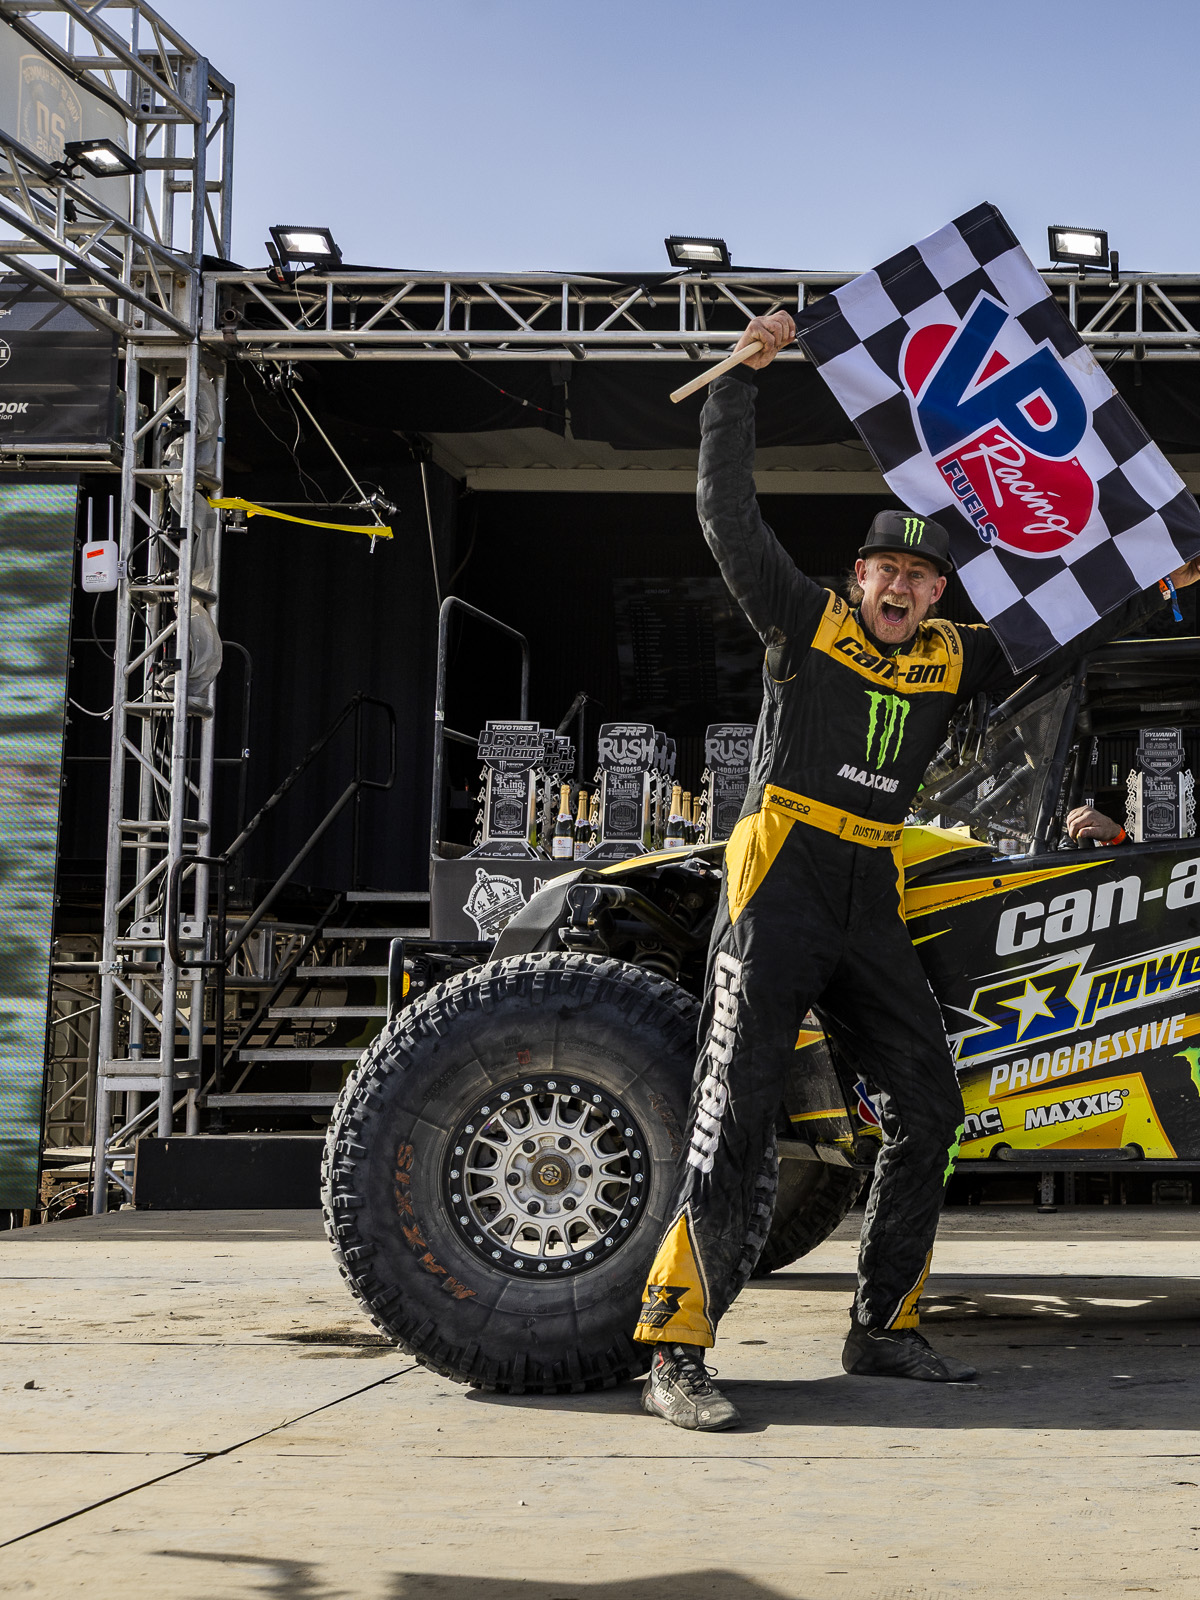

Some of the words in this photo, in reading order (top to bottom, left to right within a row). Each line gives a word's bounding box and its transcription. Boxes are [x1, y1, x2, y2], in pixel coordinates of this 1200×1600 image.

[915, 293, 1090, 461] VP
[941, 458, 999, 544] FUELS
[961, 433, 1078, 539] Racing
[833, 636, 947, 684] can-am
[477, 746, 545, 760] Challenge
[478, 730, 545, 747] Desert
[598, 737, 656, 764] RUSH
[609, 765, 642, 773] 1400/1450
[836, 763, 900, 793] MAXXIS
[769, 794, 811, 815] sparco
[852, 824, 881, 841] DUSTIN
[988, 1013, 1186, 1096] PROGRESSIVE
[394, 1143, 478, 1300] MAXXIS
